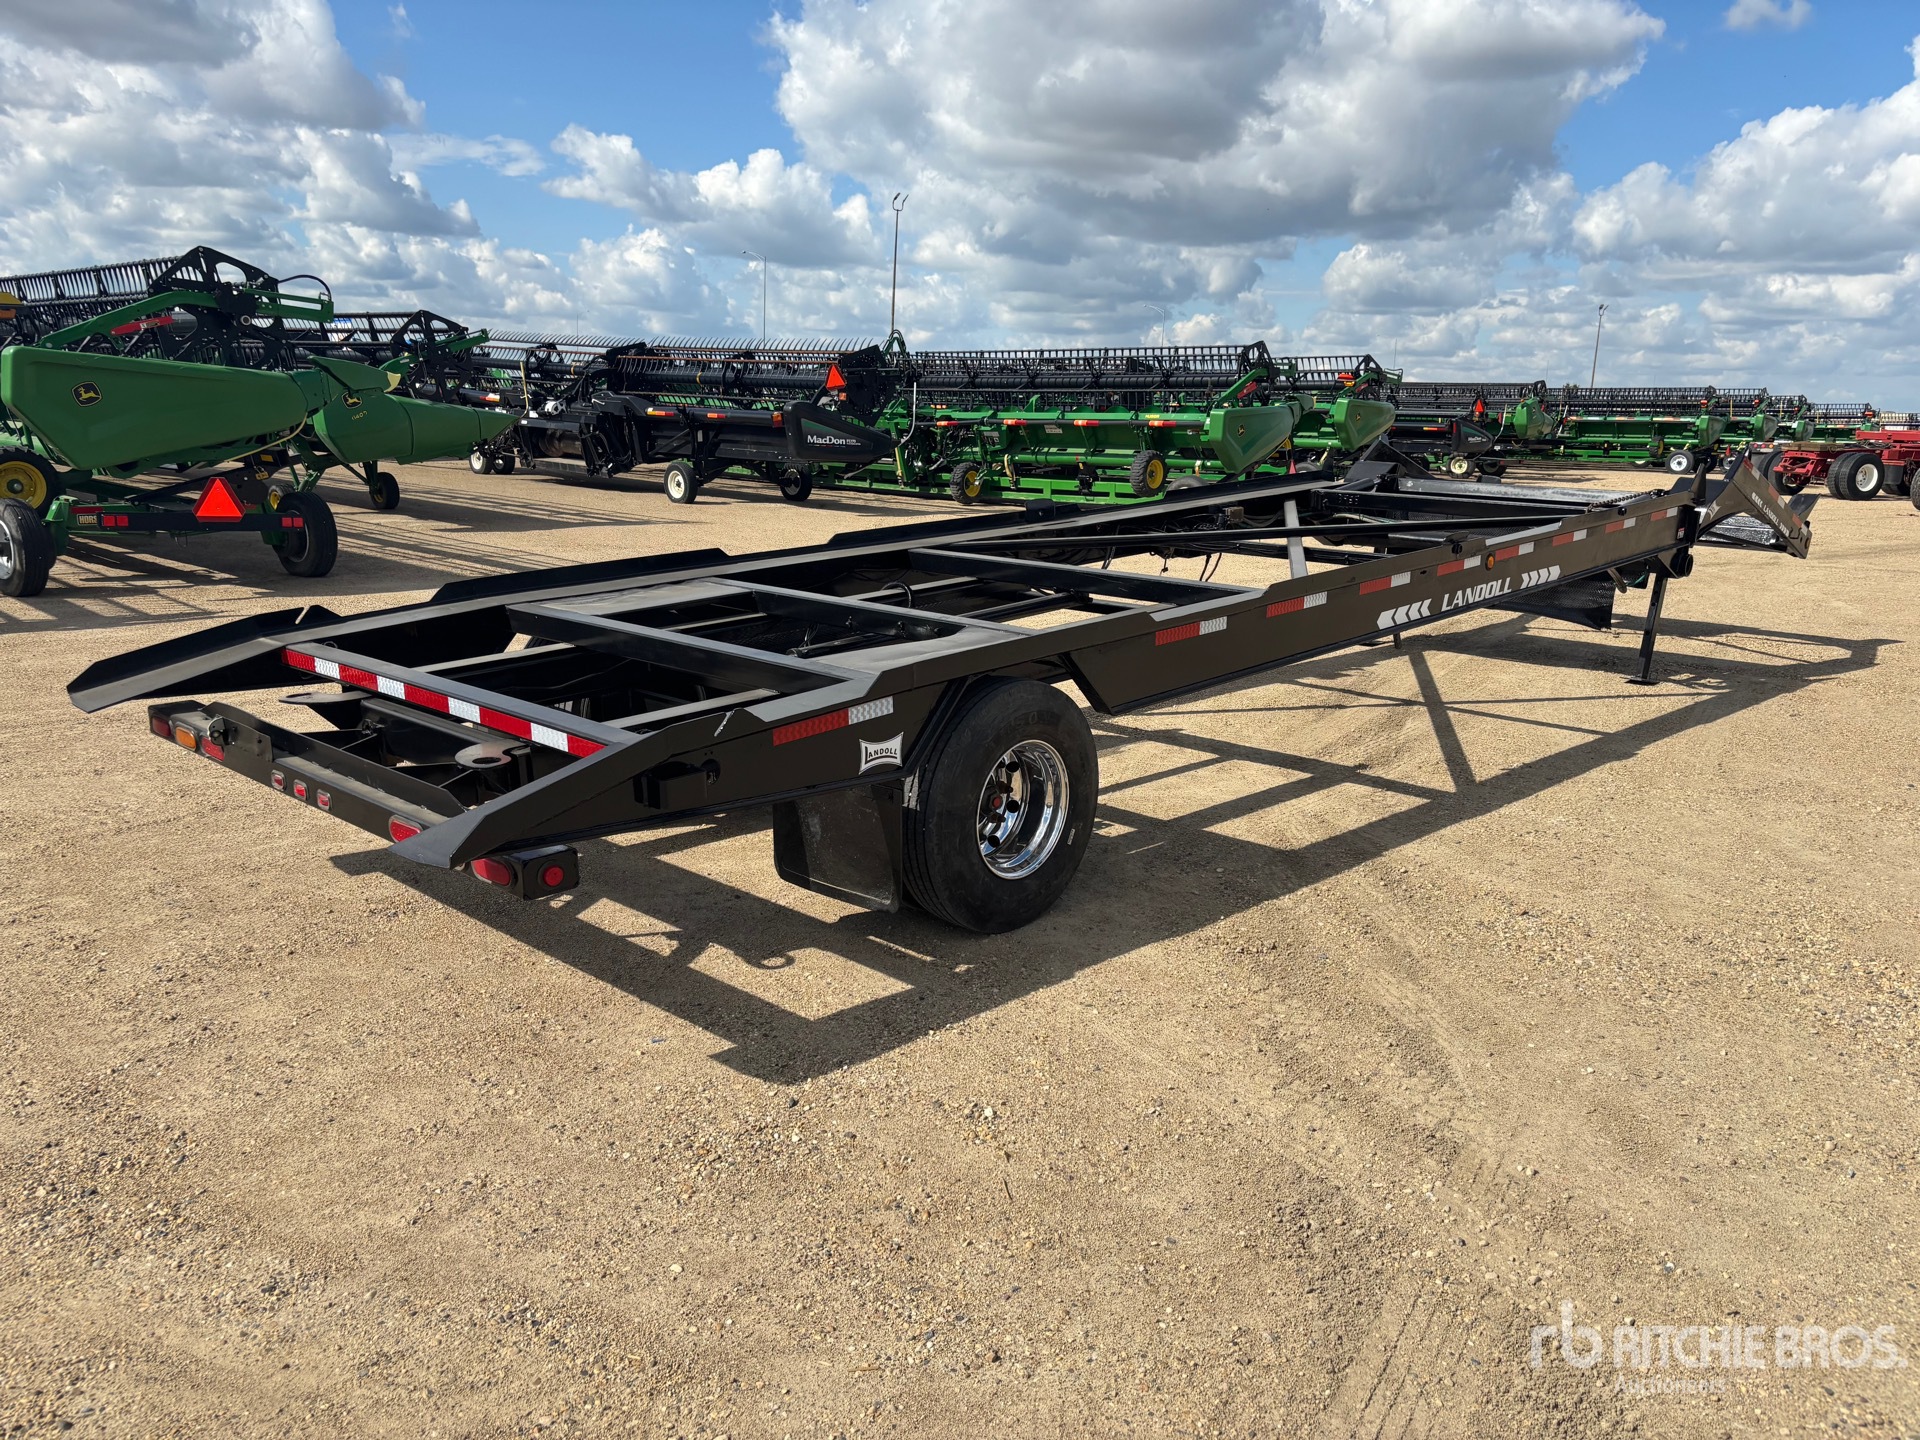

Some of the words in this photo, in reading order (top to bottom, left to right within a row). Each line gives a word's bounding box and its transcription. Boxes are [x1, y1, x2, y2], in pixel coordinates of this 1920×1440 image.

[807, 434, 846, 445] MacDon
[1441, 576, 1512, 612] LANDOLL
[865, 745, 898, 765] LANDOLL
